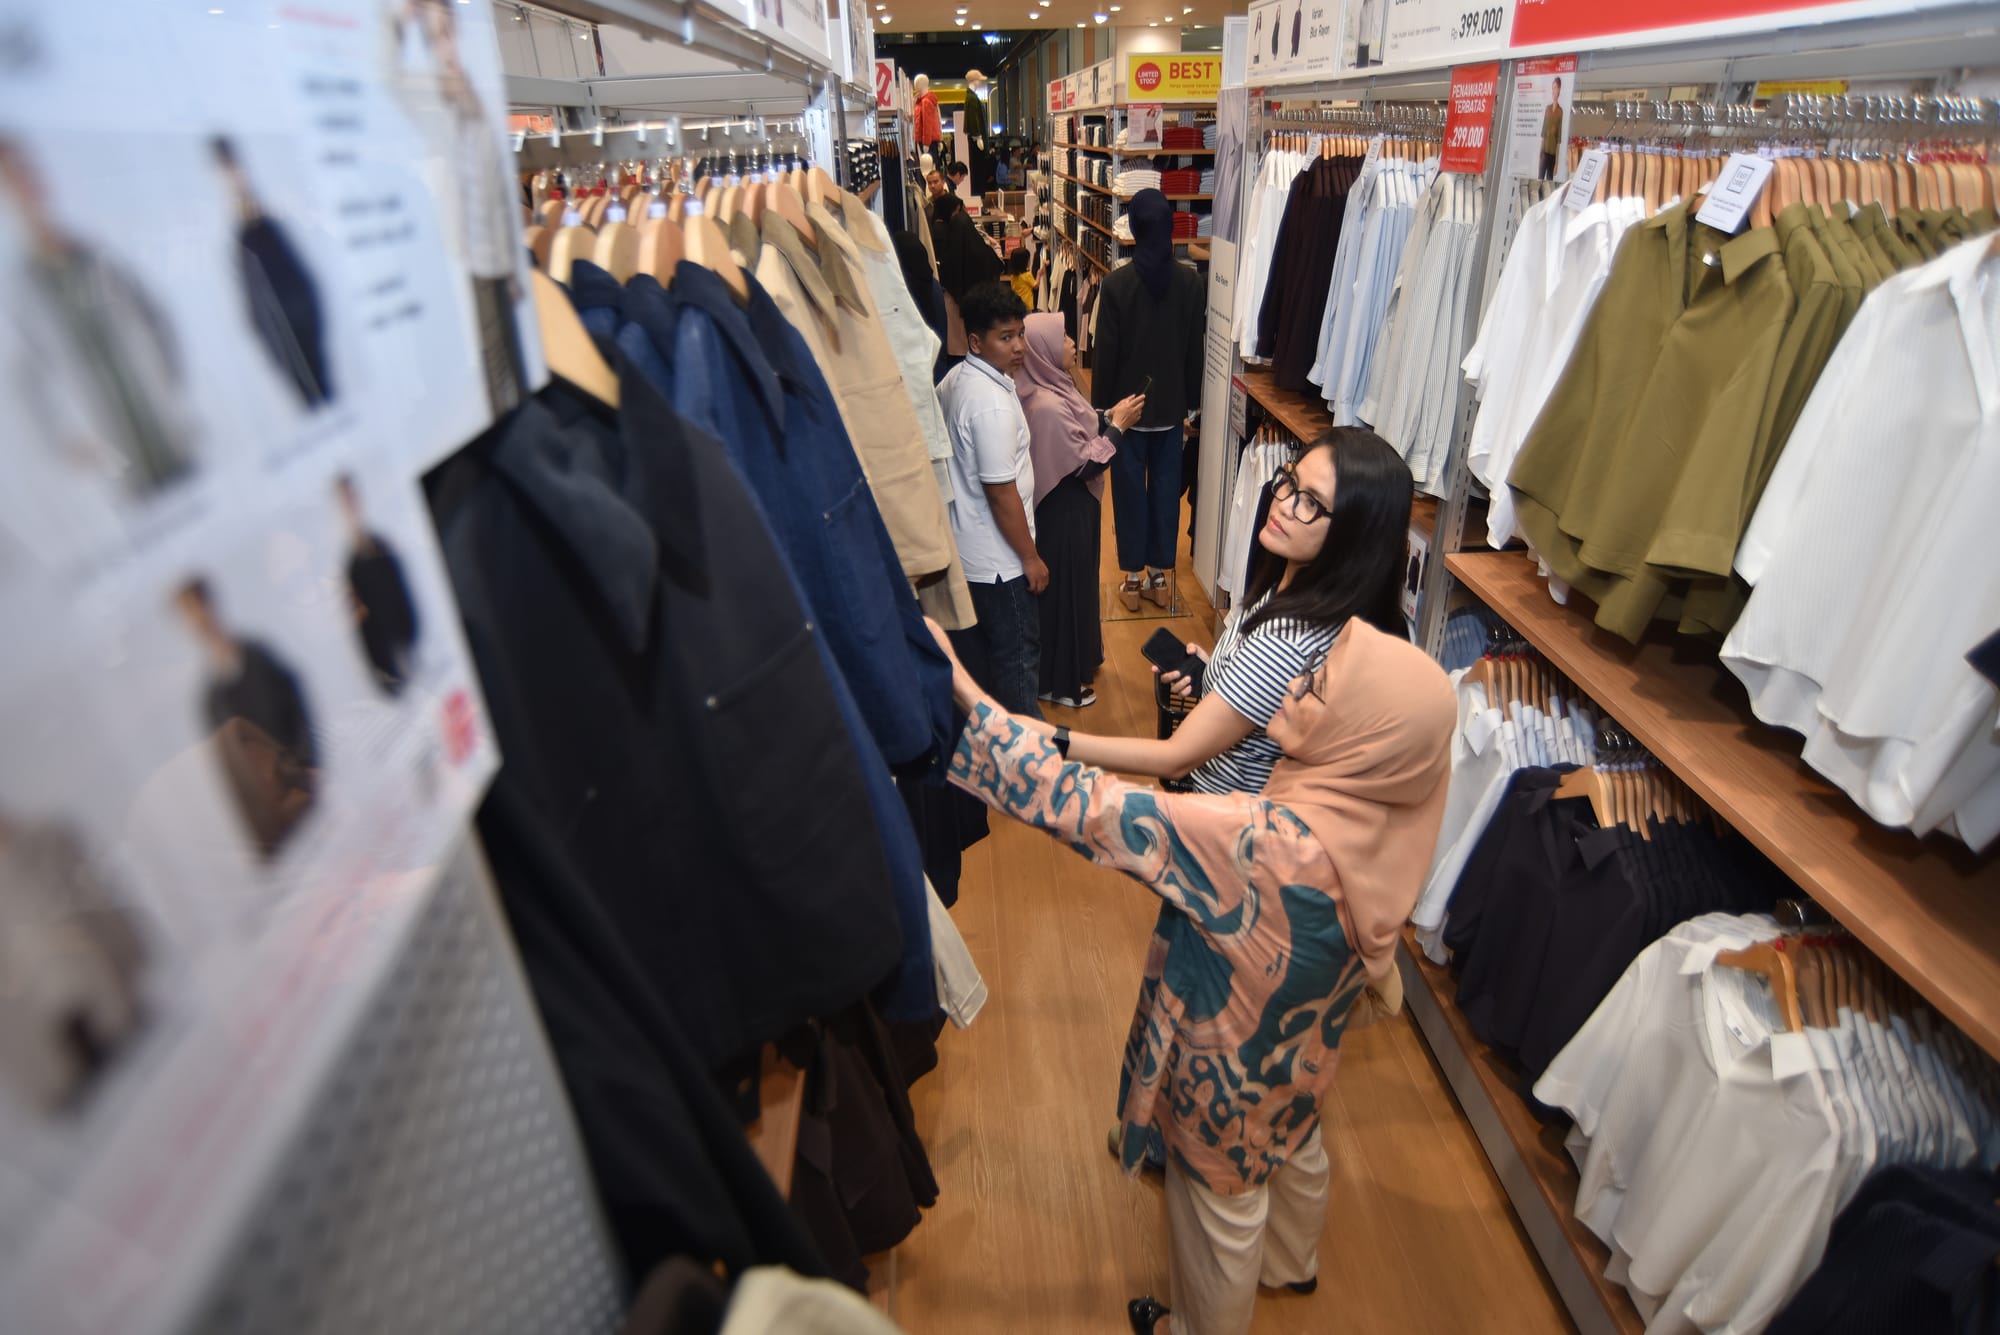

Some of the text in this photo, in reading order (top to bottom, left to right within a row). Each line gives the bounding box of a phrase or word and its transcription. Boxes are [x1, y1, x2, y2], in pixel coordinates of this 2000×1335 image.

[1459, 6, 1504, 38] 399.000
[1138, 71, 1159, 79] LIMITED
[1169, 62, 1213, 80] BEST
[1140, 78, 1156, 86] STOCK
[1452, 81, 1493, 98] PENAWARAN
[1454, 99, 1486, 114] TERBATAS
[1452, 126, 1484, 148] 299.000
